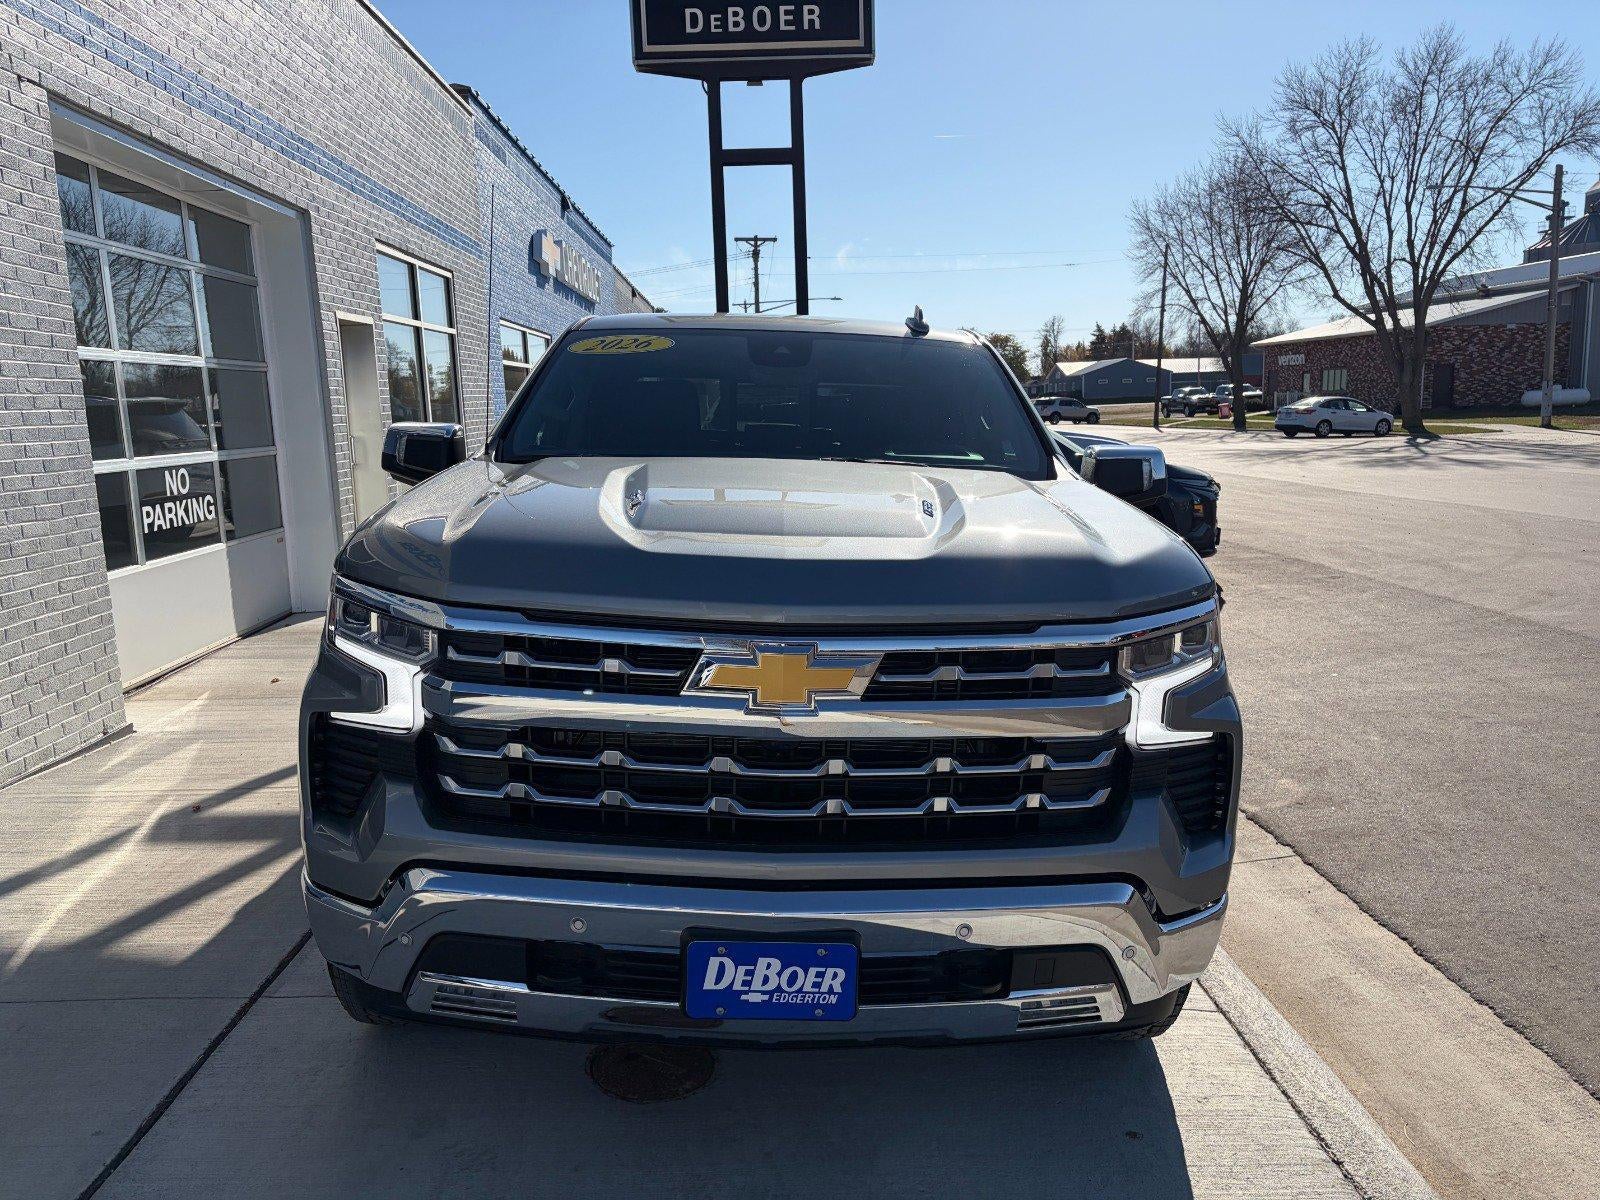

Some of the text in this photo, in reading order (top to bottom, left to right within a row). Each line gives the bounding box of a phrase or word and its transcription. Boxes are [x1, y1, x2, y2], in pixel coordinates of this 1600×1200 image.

[582, 338, 656, 352] 2026
[164, 467, 190, 496] NO
[141, 494, 216, 533] PARKING
[772, 992, 839, 1005] EDGERTON
